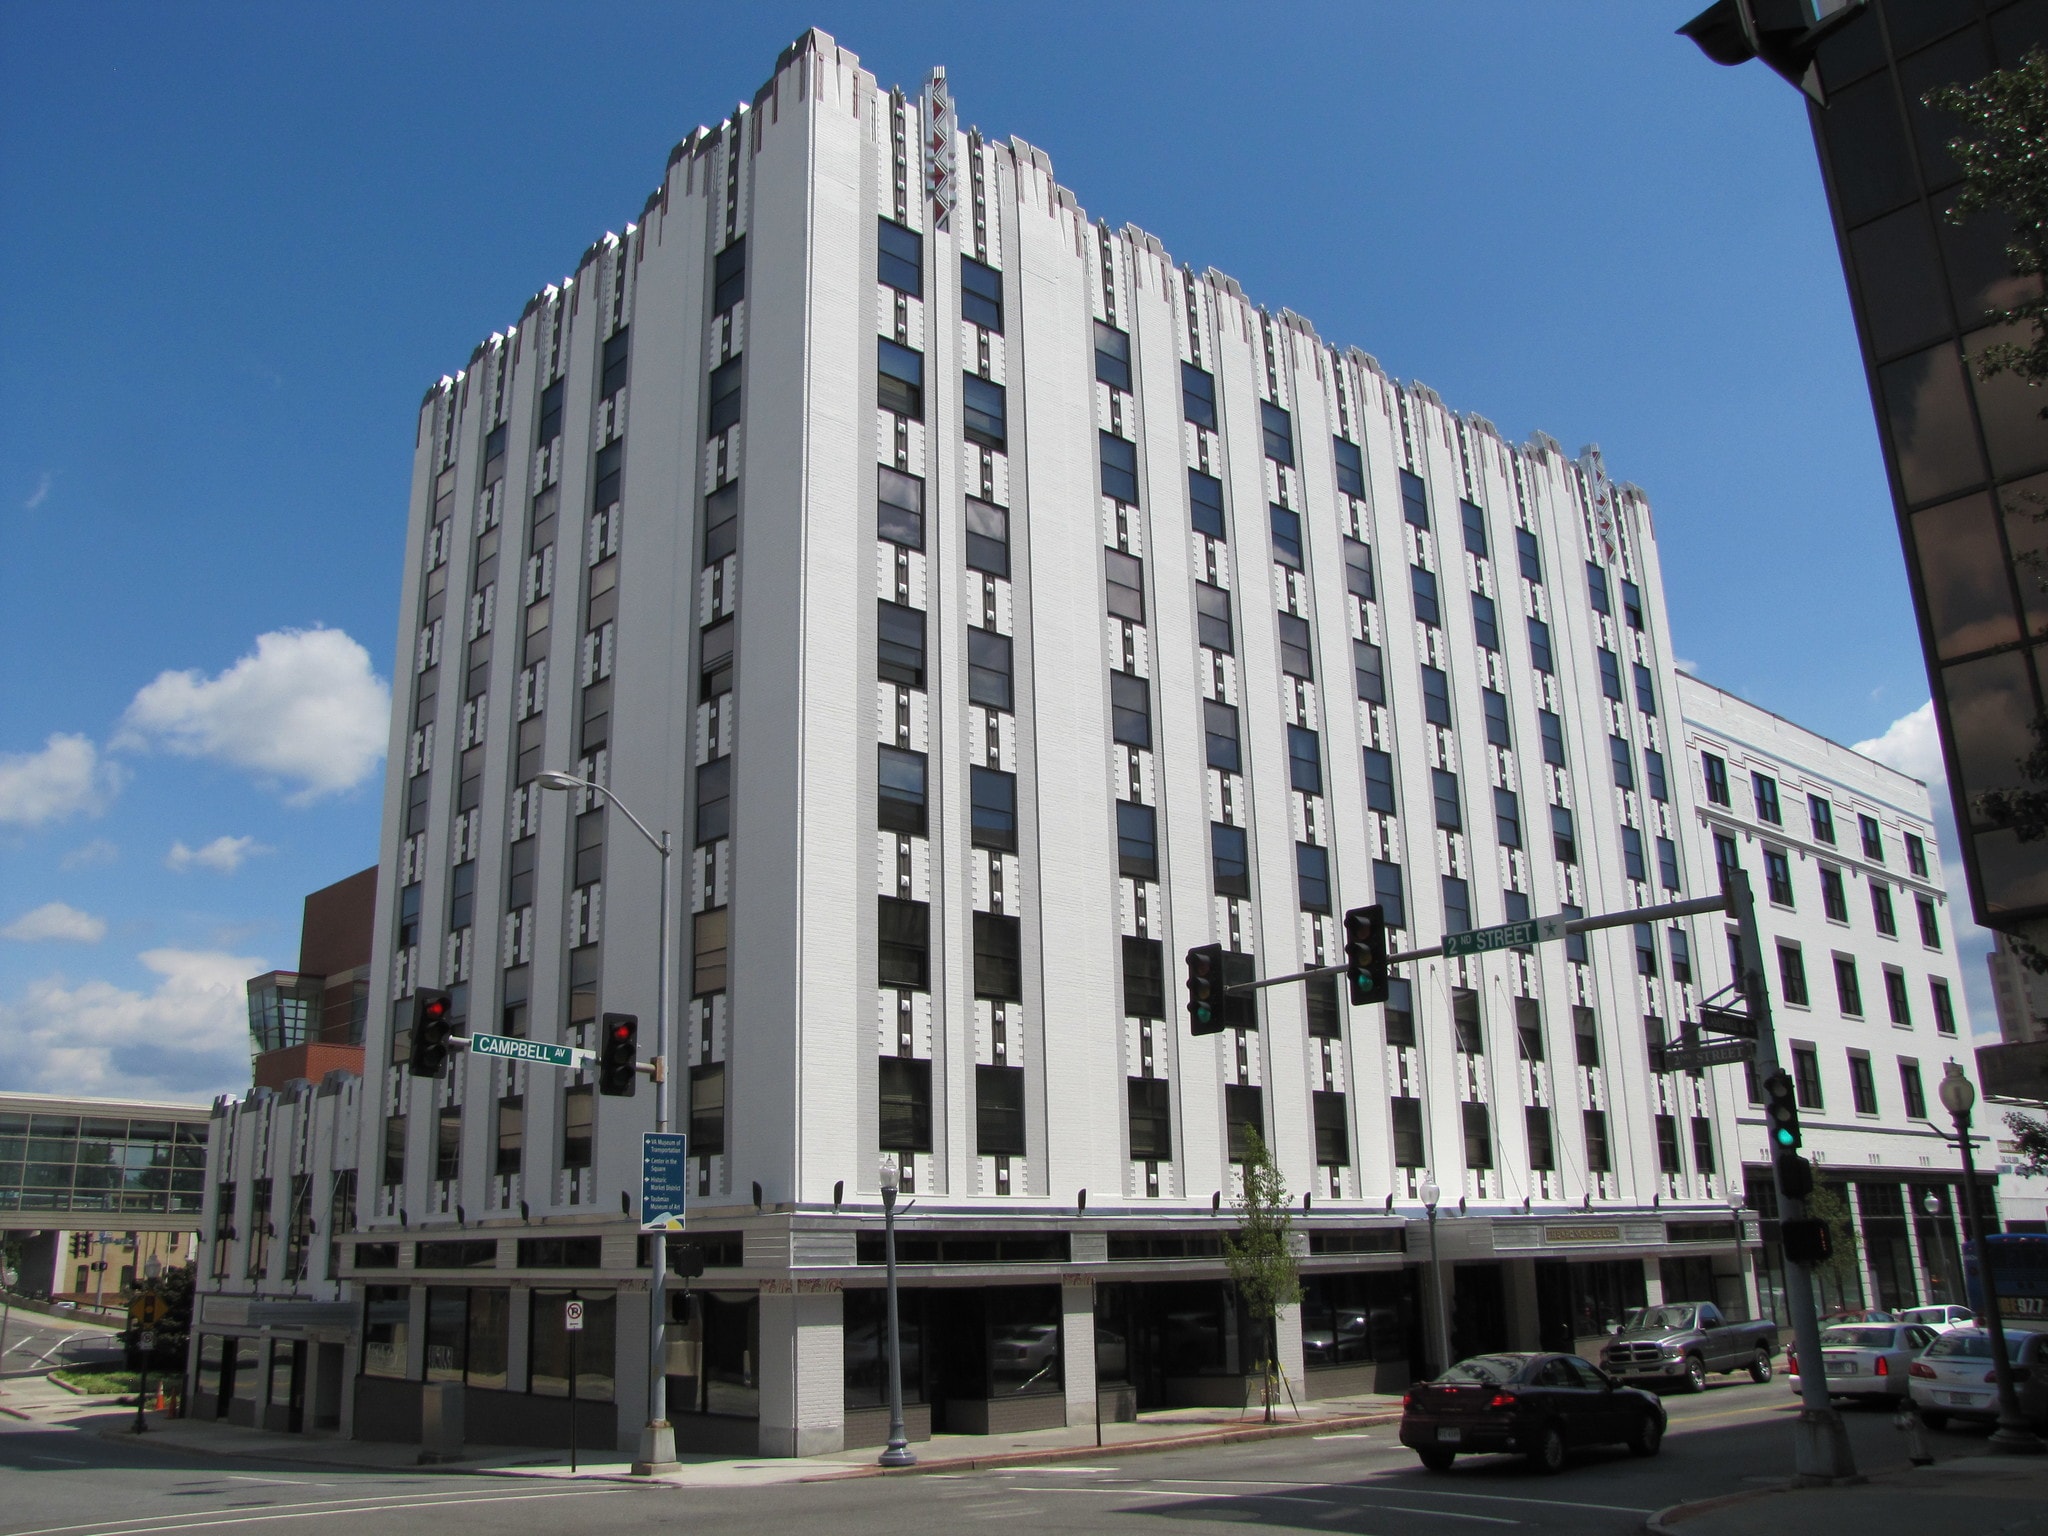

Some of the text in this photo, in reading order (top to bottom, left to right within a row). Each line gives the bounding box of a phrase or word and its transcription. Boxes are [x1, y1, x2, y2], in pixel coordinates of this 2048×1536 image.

[1476, 923, 1532, 950] STREET
[480, 1036, 566, 1061] CAMPBELL AV
[1695, 1046, 1744, 1063] STREET
[658, 1138, 675, 1146] Museum
